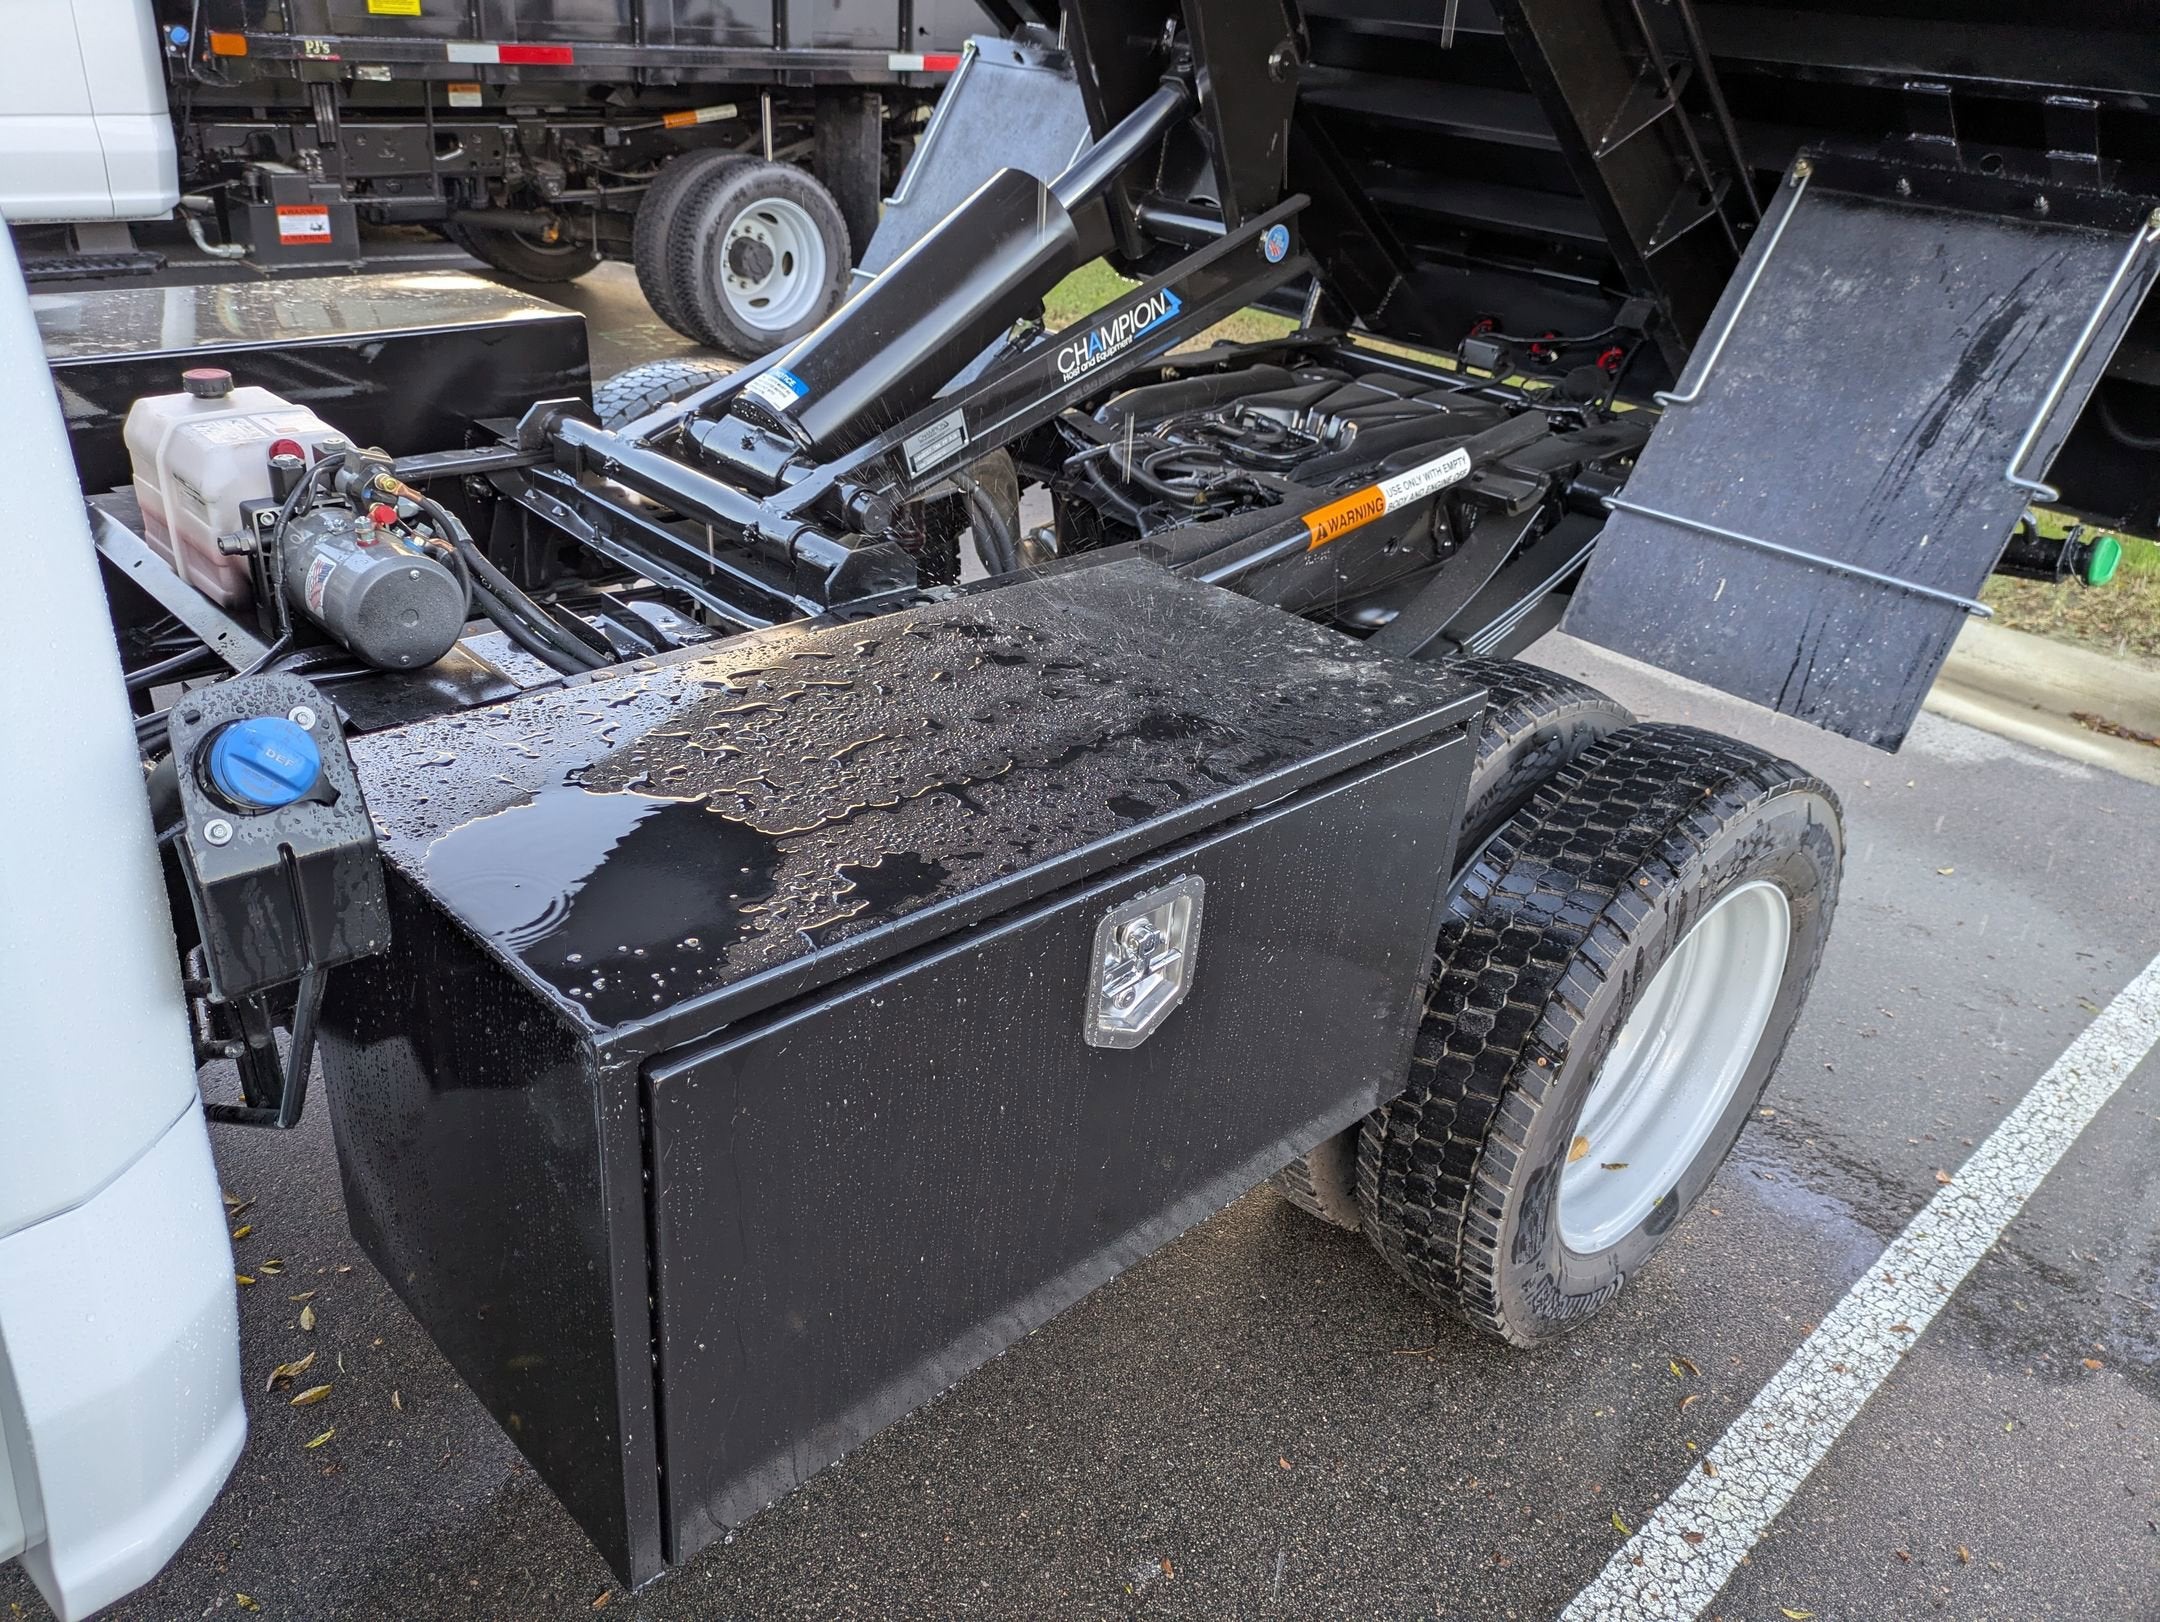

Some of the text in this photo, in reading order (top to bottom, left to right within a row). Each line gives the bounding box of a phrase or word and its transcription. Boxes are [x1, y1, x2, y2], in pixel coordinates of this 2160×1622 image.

[1057, 292, 1165, 374] CHAMPION
[1063, 334, 1133, 382] Hoist and Equipment
[1386, 455, 1466, 498] USE ONLY WITH EMPTY
[1388, 468, 1468, 511] BODY AND ENGINE OFF
[1328, 497, 1385, 533] WARNING
[265, 748, 295, 768] DEF
